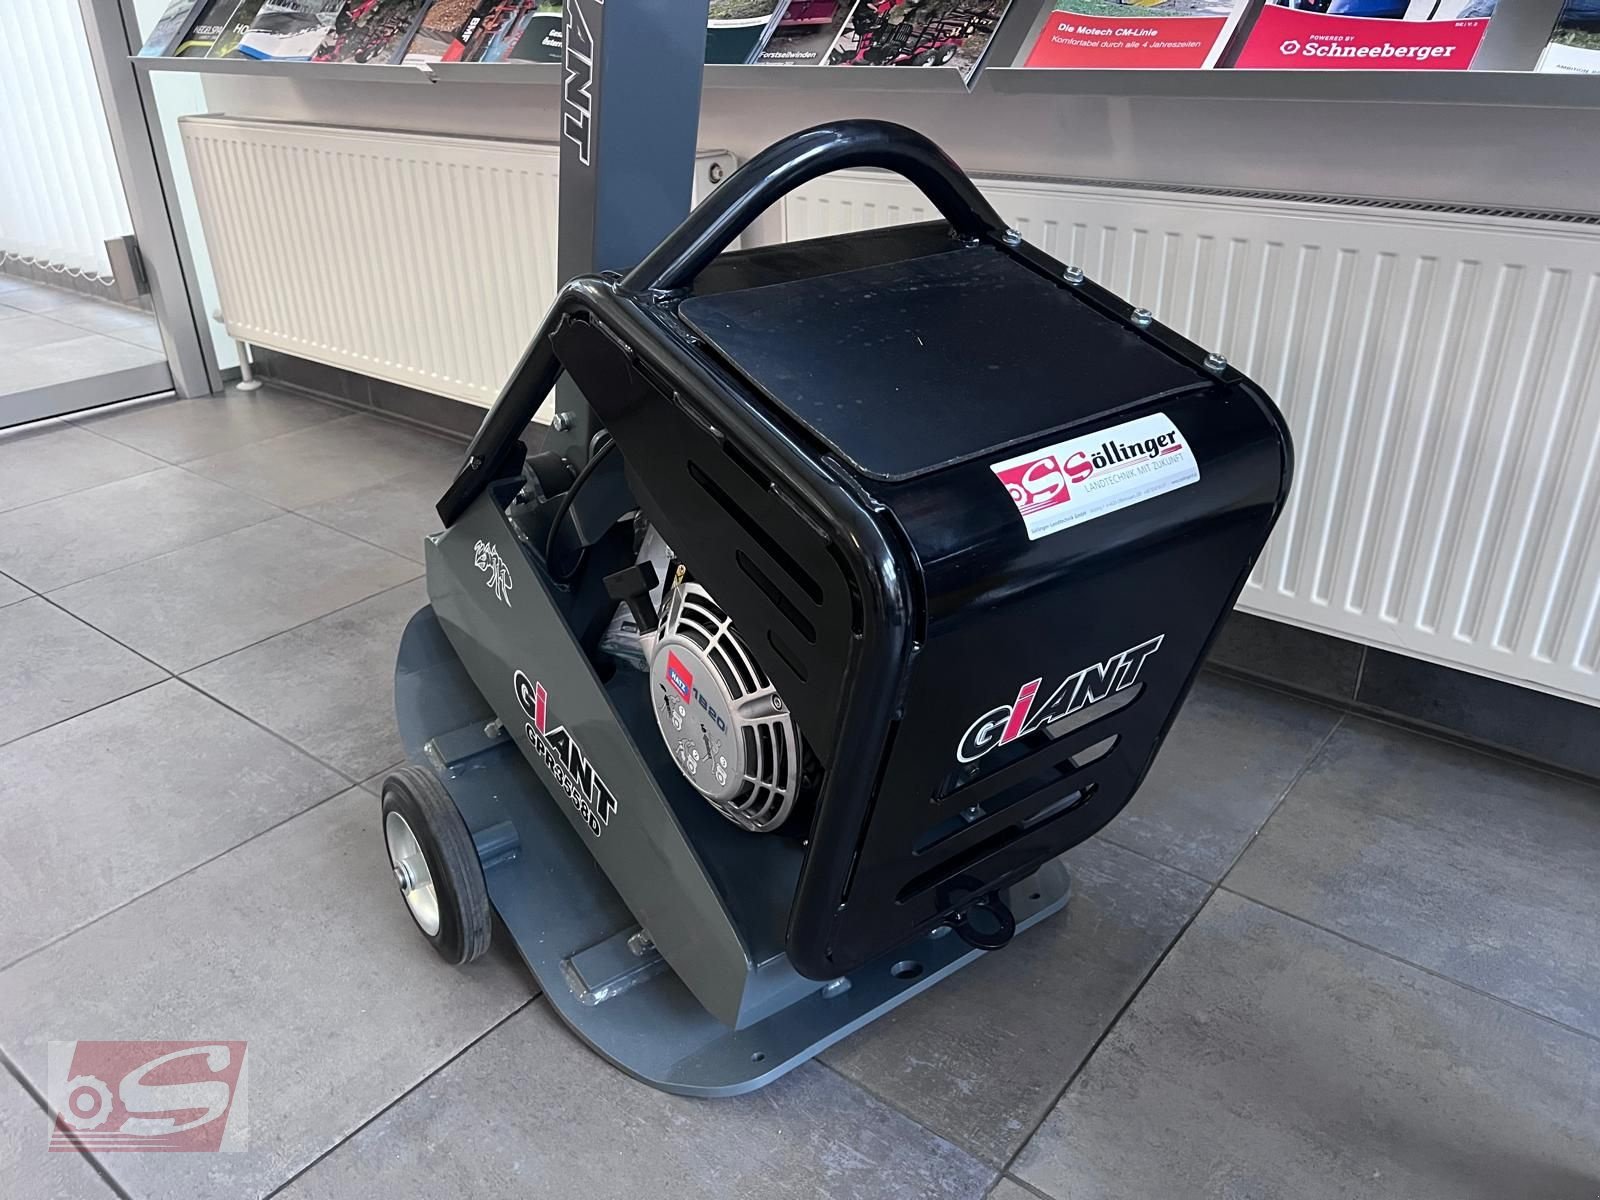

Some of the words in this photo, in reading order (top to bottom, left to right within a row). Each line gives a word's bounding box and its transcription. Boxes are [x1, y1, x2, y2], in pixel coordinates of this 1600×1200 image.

[233, 23, 250, 35] HO
[461, 17, 481, 43] BMF
[1058, 23, 1075, 33] Die
[1076, 26, 1113, 36] Motech
[1115, 28, 1158, 37] CM-Linie
[1051, 35, 1100, 48] Komfortabel
[1100, 40, 1124, 48] durch
[1302, 42, 1456, 60] Schneeberger
[564, 0, 593, 166] ANT
[1064, 430, 1176, 484] Söllinger
[1084, 467, 1137, 493] LANDTECHNIK
[1137, 463, 1152, 475] MIT
[1152, 452, 1185, 470] ZUKUNFT
[671, 670, 687, 693] HATZ
